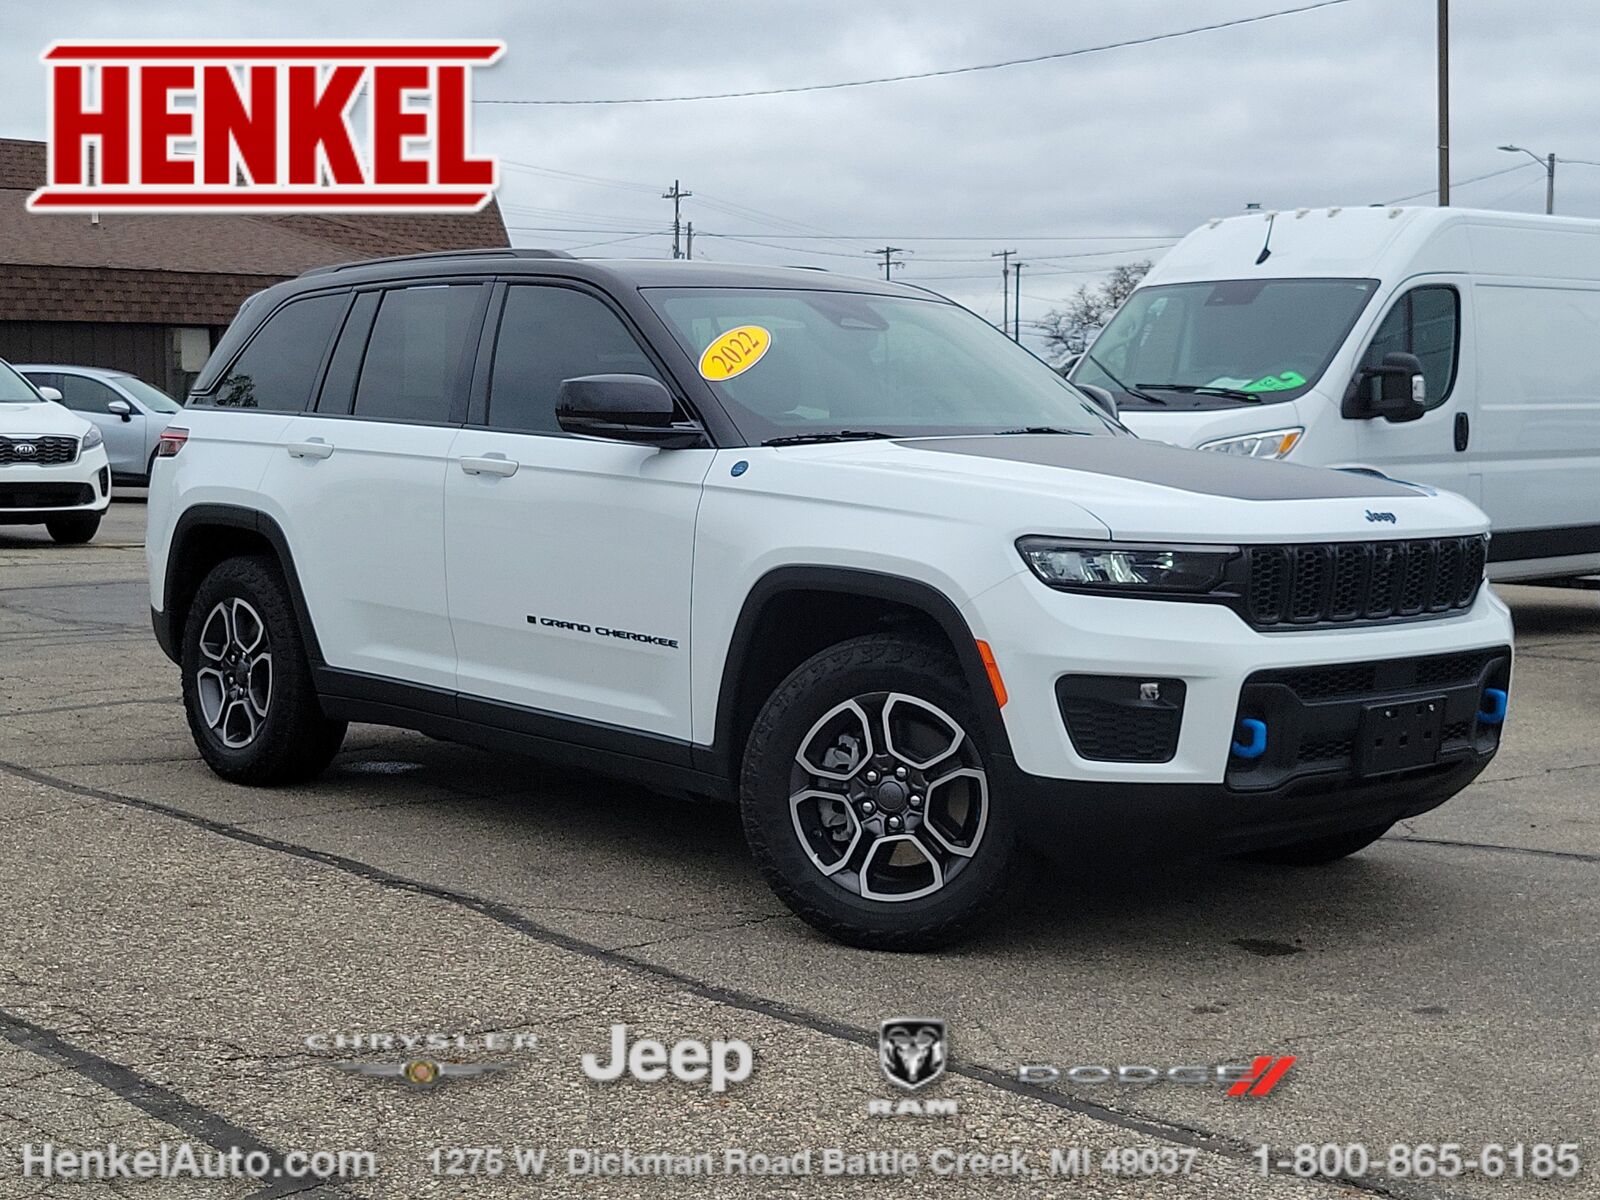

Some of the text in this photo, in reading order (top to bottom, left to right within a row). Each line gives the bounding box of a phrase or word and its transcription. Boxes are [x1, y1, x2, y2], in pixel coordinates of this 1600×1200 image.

[711, 331, 760, 374] 2022
[1365, 509, 1397, 525] Jeep
[540, 617, 680, 649] GRAND CHEROKEE
